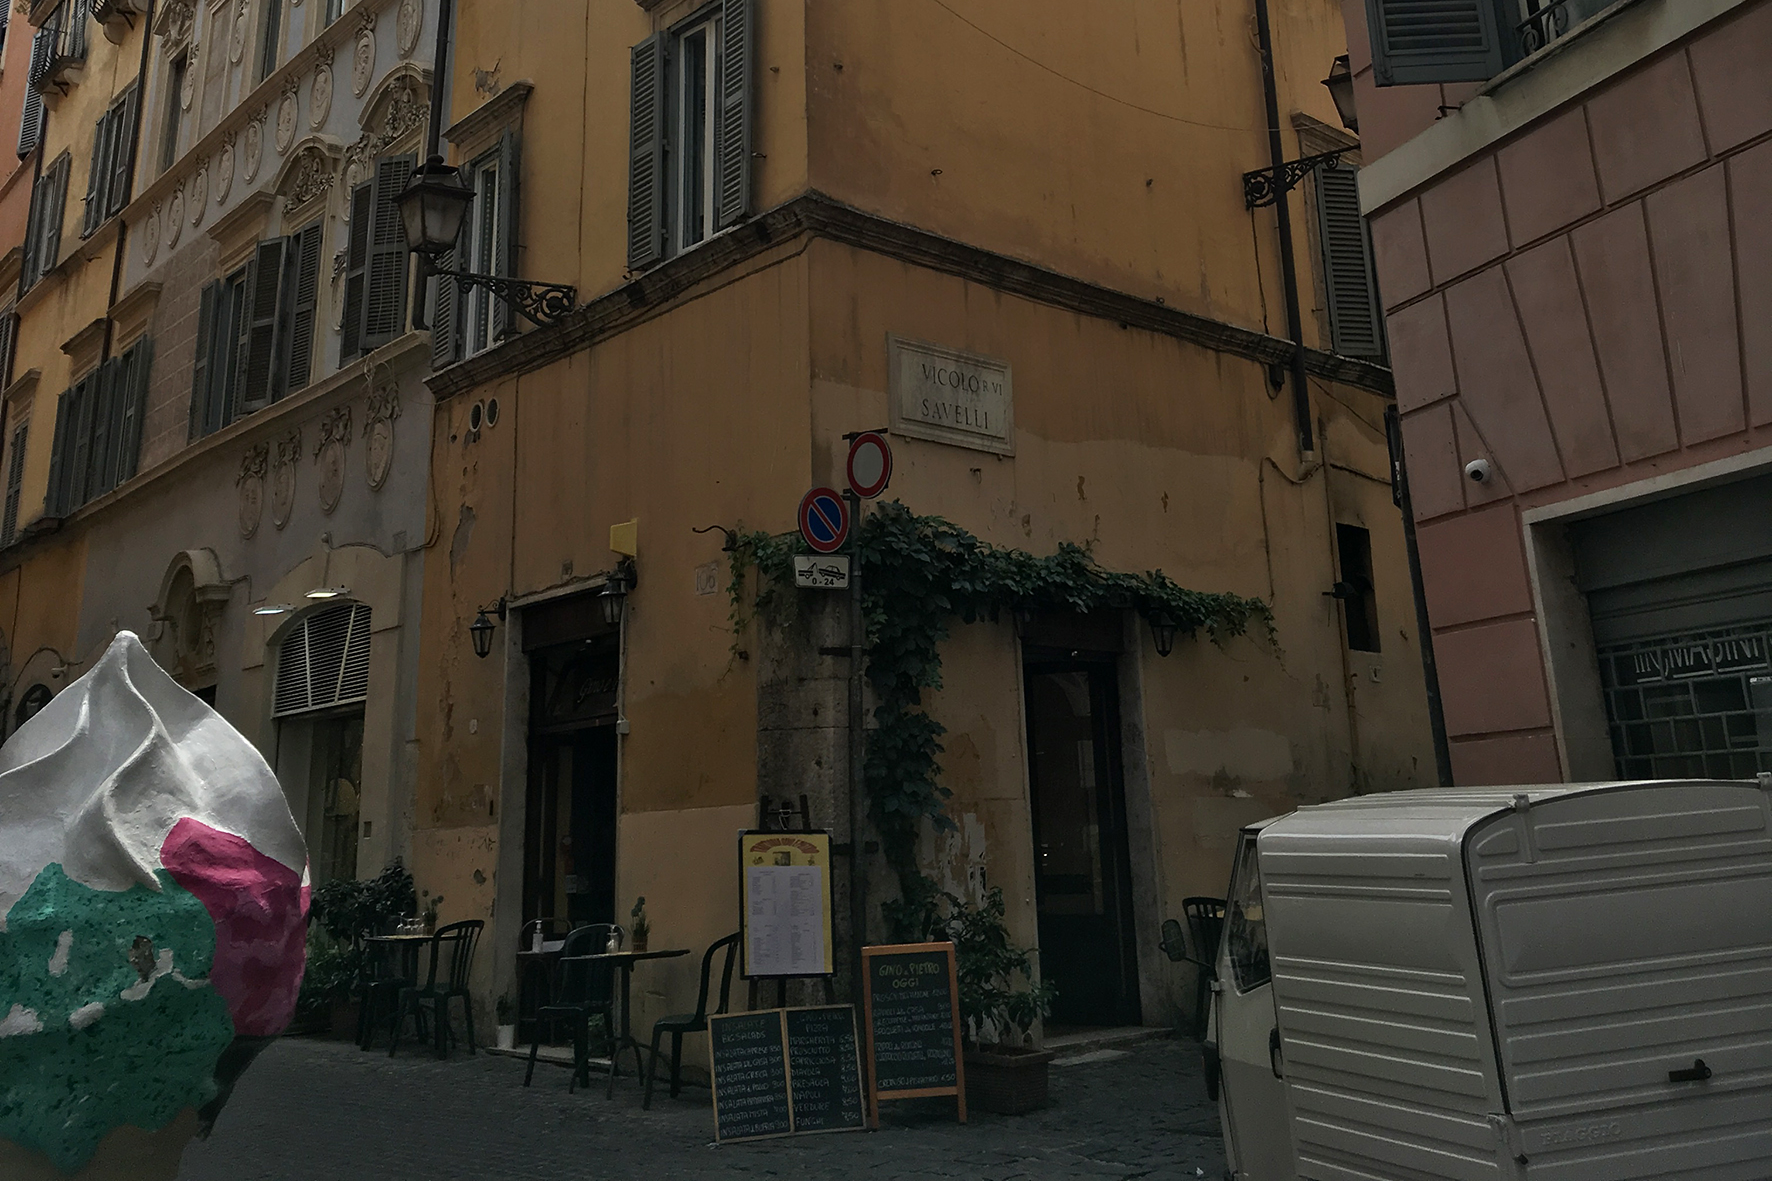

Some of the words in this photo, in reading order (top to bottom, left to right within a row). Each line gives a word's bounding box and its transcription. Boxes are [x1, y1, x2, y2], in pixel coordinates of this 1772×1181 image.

[922, 363, 979, 393] VICOLO
[922, 398, 988, 430] SAVELLI
[879, 964, 903, 976] GINO
[909, 961, 940, 975] PIETRO
[892, 978, 919, 989] OGGI
[805, 1023, 829, 1033] PIZZA
[735, 1031, 766, 1041] SALADS
[791, 1067, 821, 1076] DIAVOLA
[792, 1078, 830, 1088] BRESAOLA
[793, 1090, 821, 1100] NAPOLI
[793, 1102, 830, 1112] VERDURE
[749, 1109, 768, 1118] MISTA
[796, 1117, 824, 1127] FUNGHI
[1540, 1122, 1622, 1146] PIAGGIO
